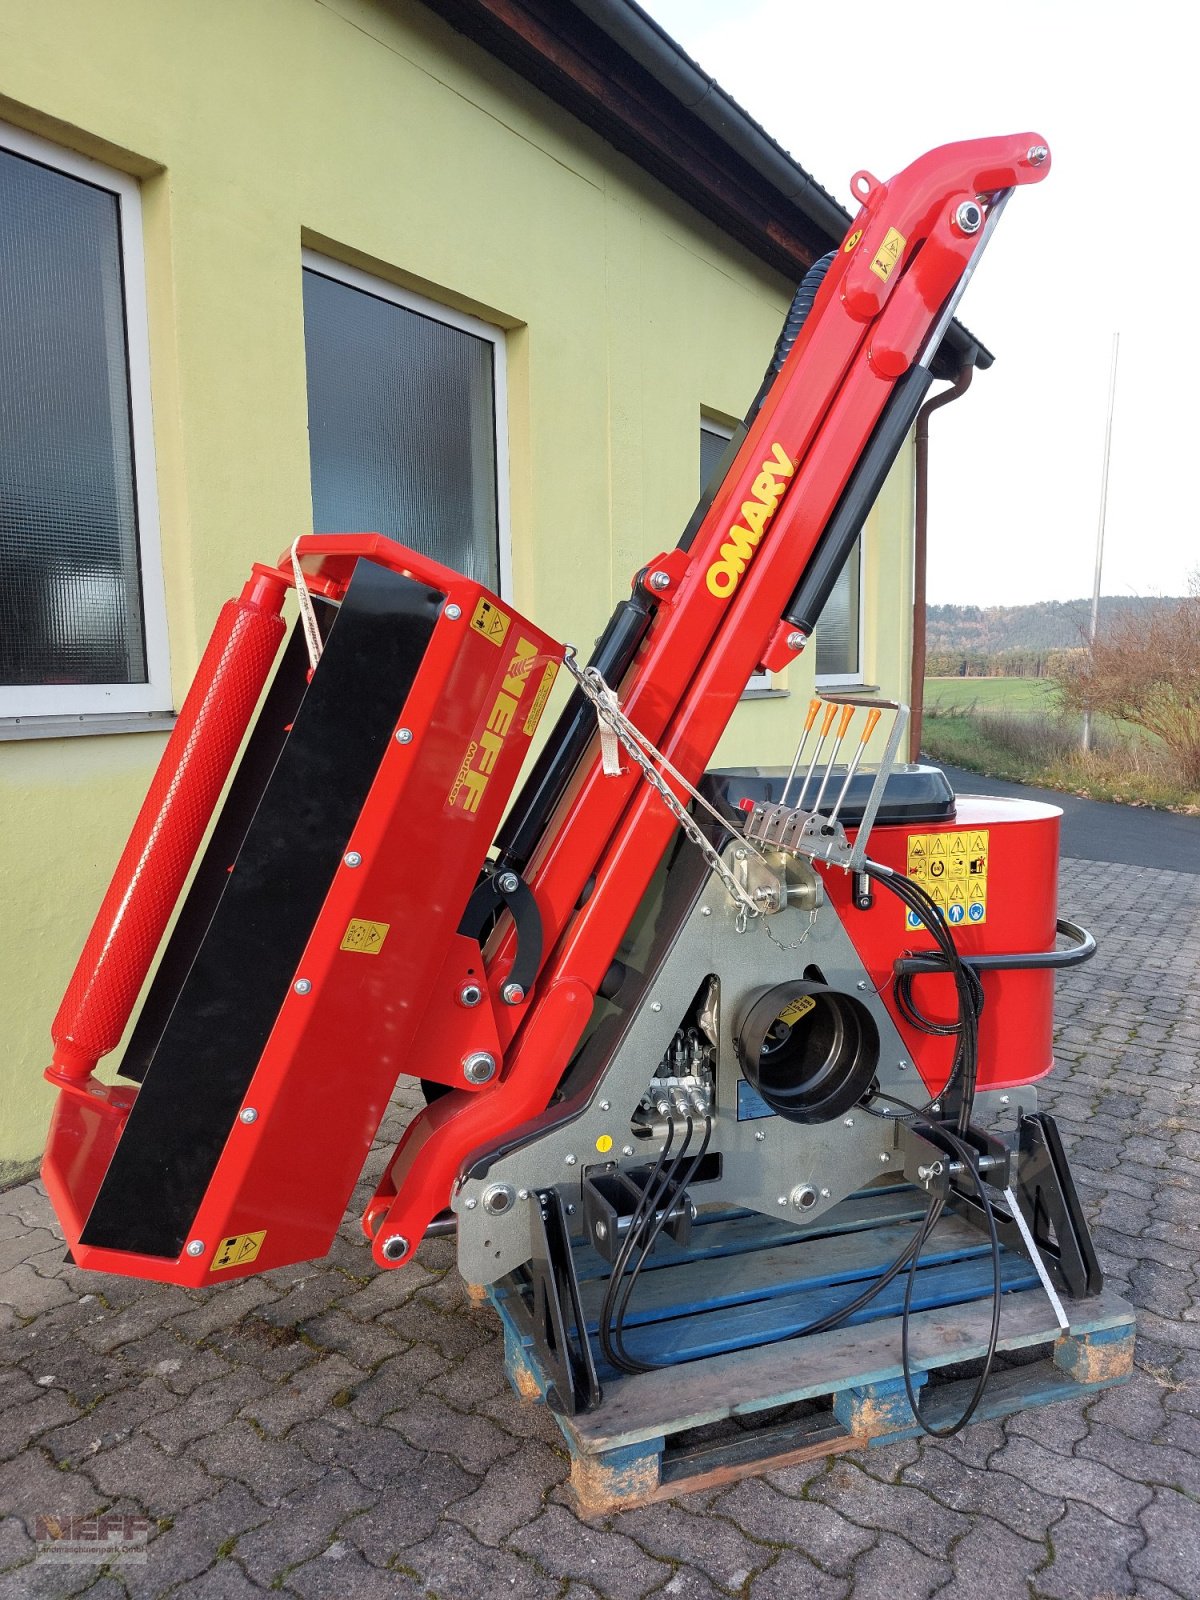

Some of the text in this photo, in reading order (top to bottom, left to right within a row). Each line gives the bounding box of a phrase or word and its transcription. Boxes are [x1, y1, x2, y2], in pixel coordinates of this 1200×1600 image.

[706, 442, 794, 598] OMARV
[449, 741, 477, 805] Mulcher
[463, 636, 538, 813] NEFF
